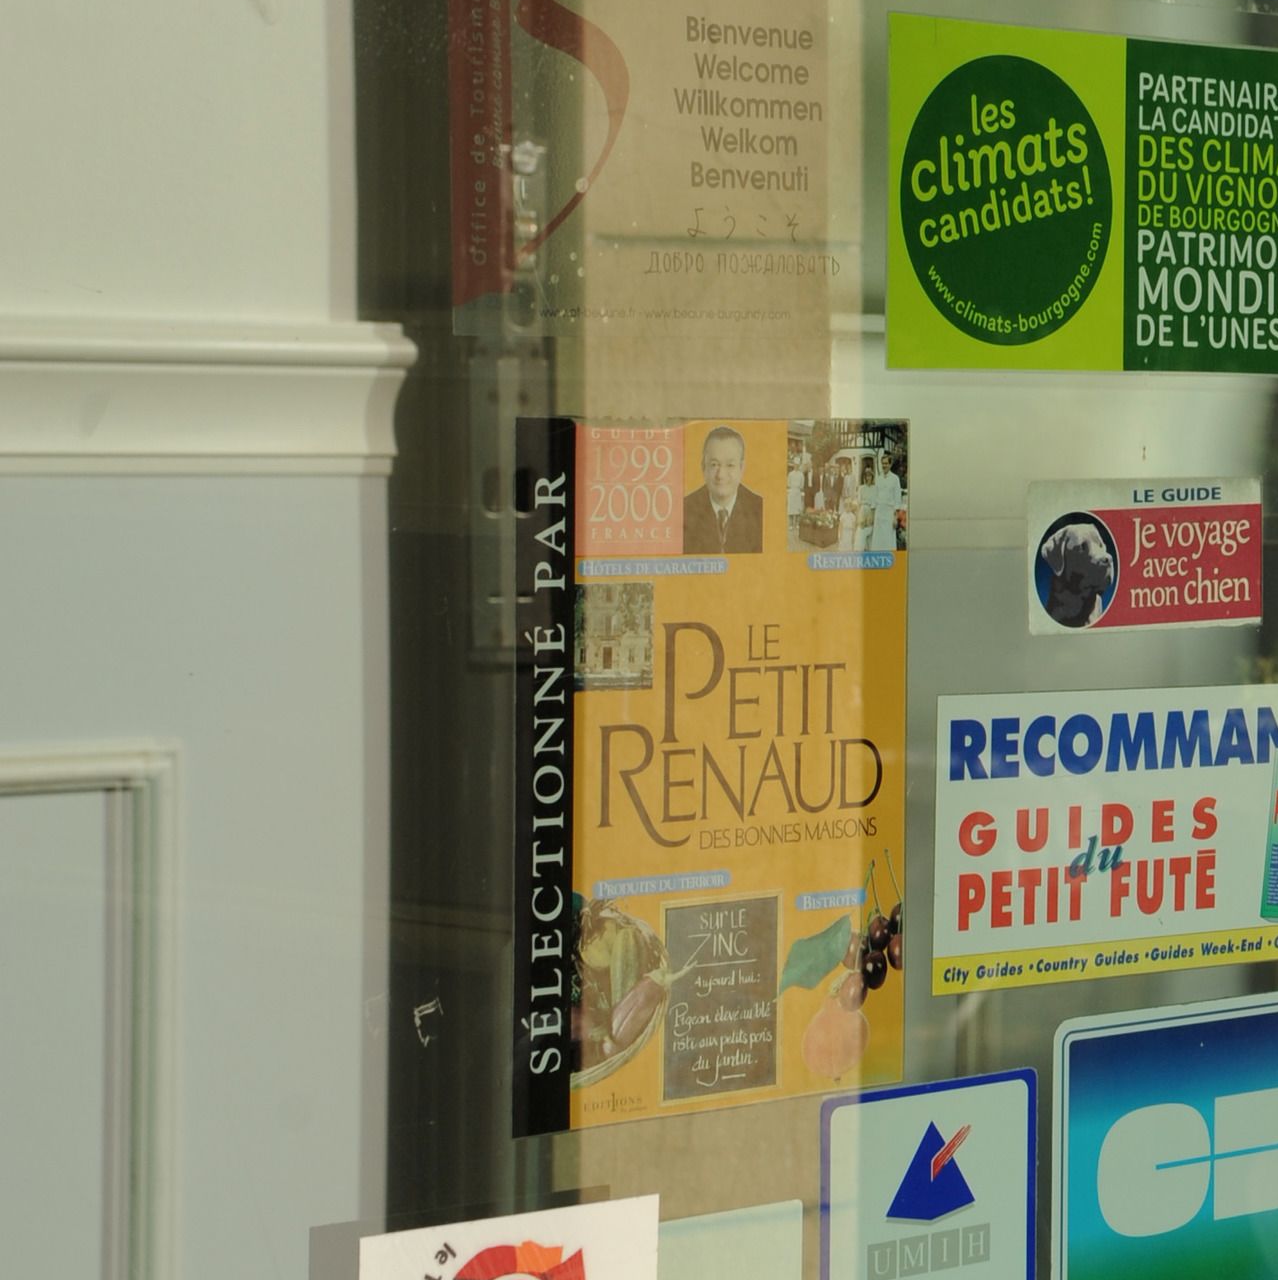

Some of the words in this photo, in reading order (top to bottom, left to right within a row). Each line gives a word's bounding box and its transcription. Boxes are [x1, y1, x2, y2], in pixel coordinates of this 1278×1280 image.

[686, 15, 814, 50] Bienvenue
[694, 52, 809, 86] Welcome
[674, 88, 823, 122] Willkommen
[970, 94, 1016, 136] les
[1139, 105, 1167, 132] LA
[701, 125, 798, 157] Welkom
[1138, 134, 1194, 170] DES
[691, 161, 809, 192] Benvenuti
[911, 118, 1089, 203] climats
[1138, 170, 1178, 204] DU
[919, 165, 1094, 248] candidats!
[1138, 204, 1164, 228] DE
[1136, 314, 1174, 348] DE
[593, 445, 673, 482] 1999
[589, 484, 673, 523] 2000
[1133, 488, 1154, 503] LE
[1162, 486, 1222, 502] GUIDE
[534, 470, 567, 592] PAR
[591, 527, 672, 540] FRANCE
[1130, 518, 1156, 567] Je
[1161, 519, 1250, 560] voyage
[1143, 555, 1188, 578] avec
[1130, 586, 1179, 608] mon
[1184, 567, 1250, 604] chien
[747, 624, 781, 662] LE
[660, 621, 846, 744] PETIT
[597, 724, 883, 849] RENAUD
[700, 830, 731, 850] DES
[735, 823, 801, 847] BONNES
[805, 817, 878, 842] MAISONS
[958, 797, 1218, 857] GUIDES
[521, 620, 566, 1074] SÉLECTIONNÉ
[957, 863, 1089, 931] PETIT
[1110, 849, 1217, 918] FUTÉ
[684, 930, 749, 970] ZINC
[943, 968, 969, 987] City
[976, 962, 1023, 980] Guides
[1036, 956, 1088, 975] Country
[1095, 951, 1140, 967] Guides
[1200, 936, 1263, 957] Week-End
[872, 1228, 988, 1278] UMIH
